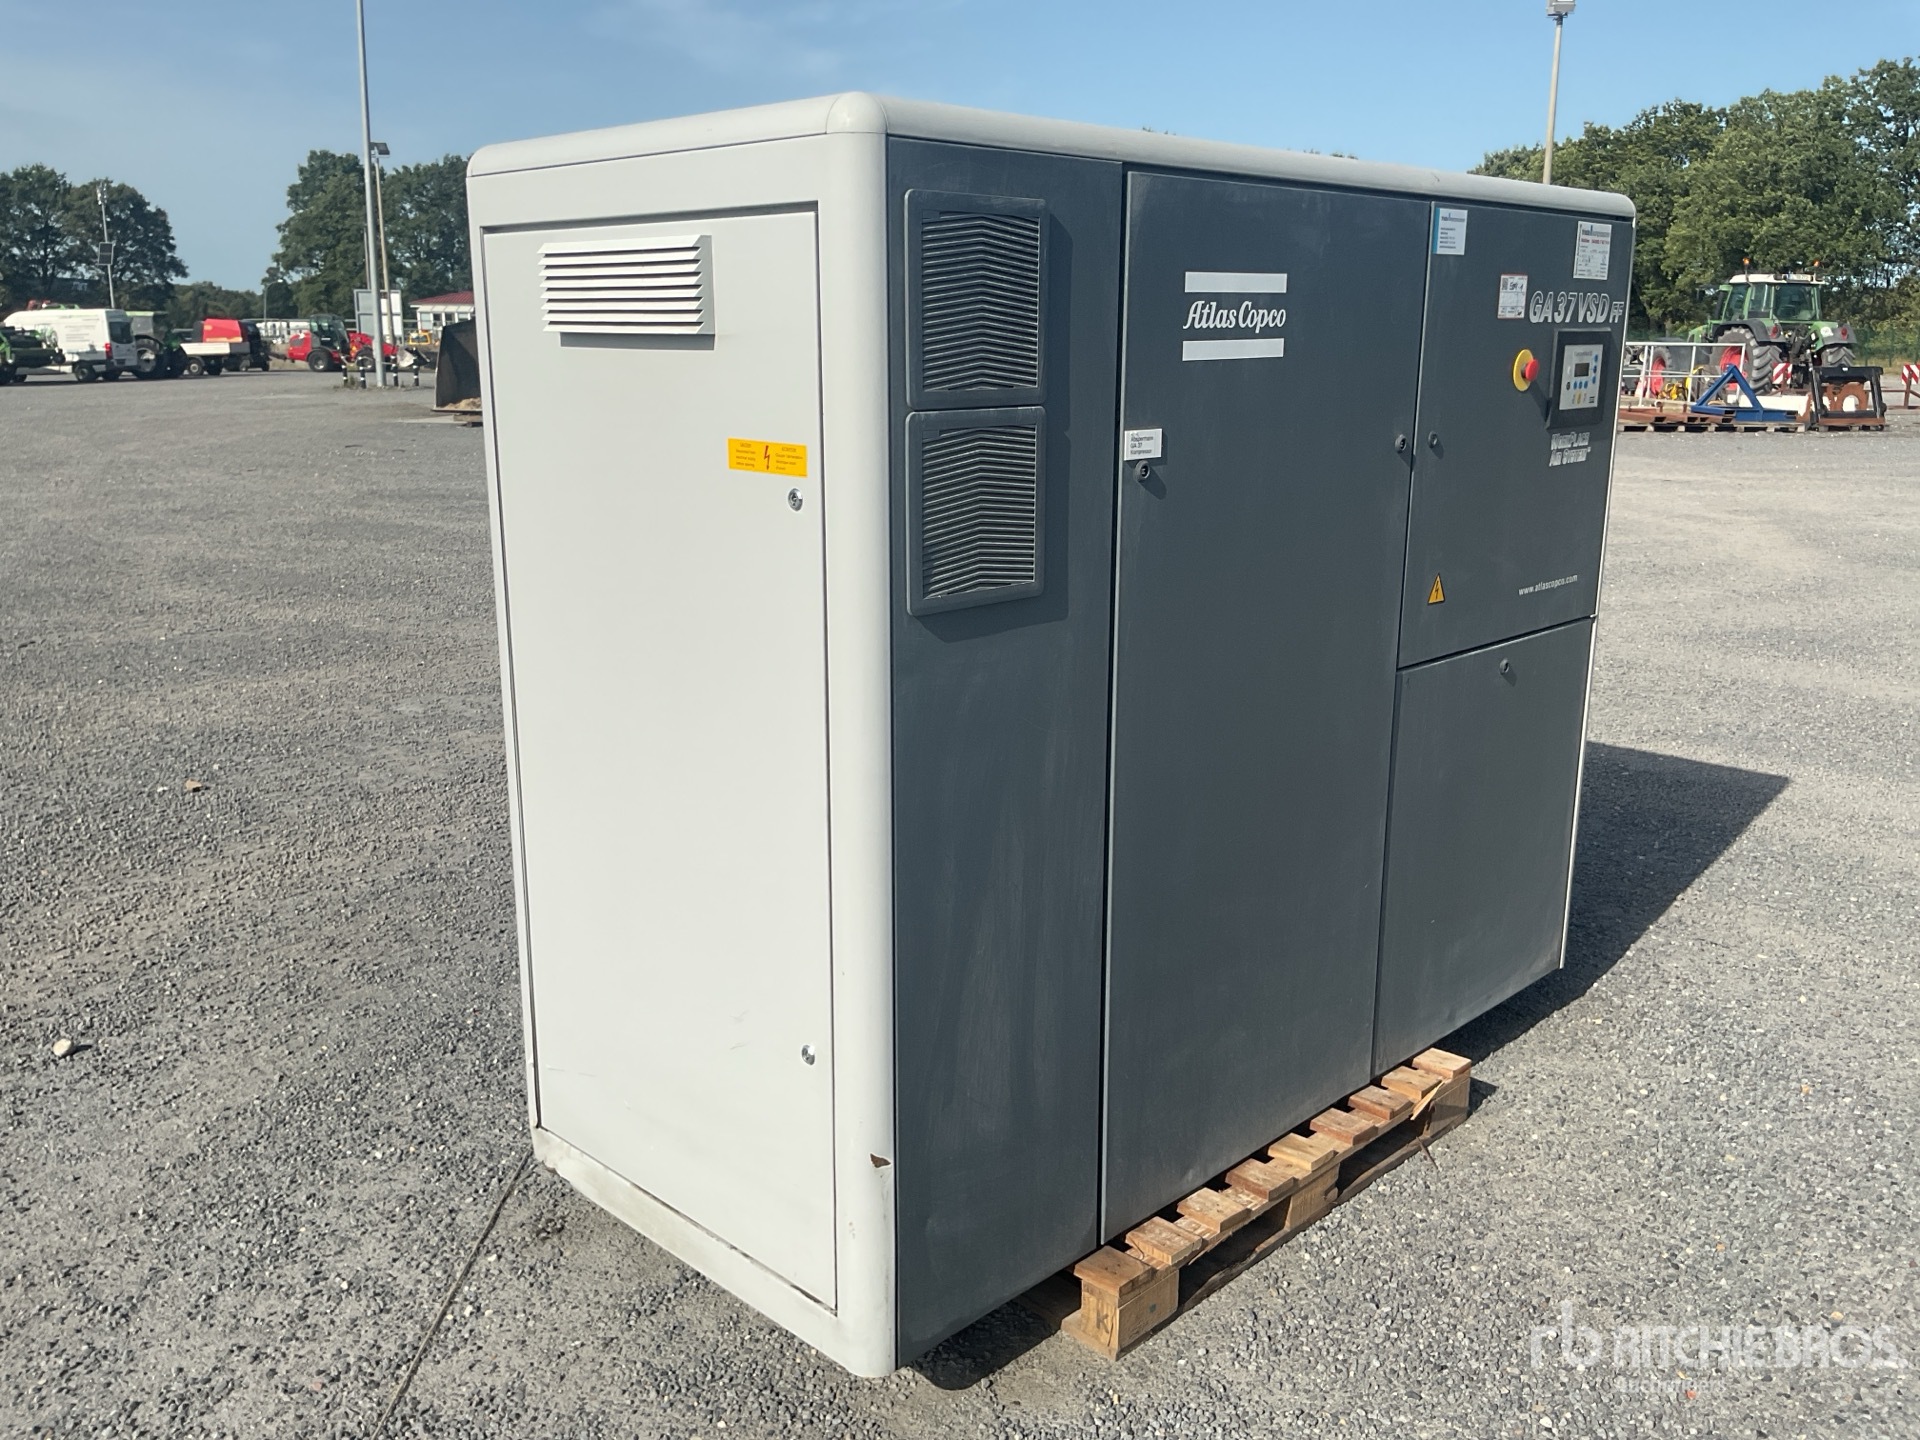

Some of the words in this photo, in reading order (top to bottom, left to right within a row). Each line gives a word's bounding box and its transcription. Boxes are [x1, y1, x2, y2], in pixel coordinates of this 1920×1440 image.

[1183, 301, 1237, 329] Atlas
[1238, 301, 1286, 333] Copco
[1518, 575, 1578, 595] www.atlascopco.com
